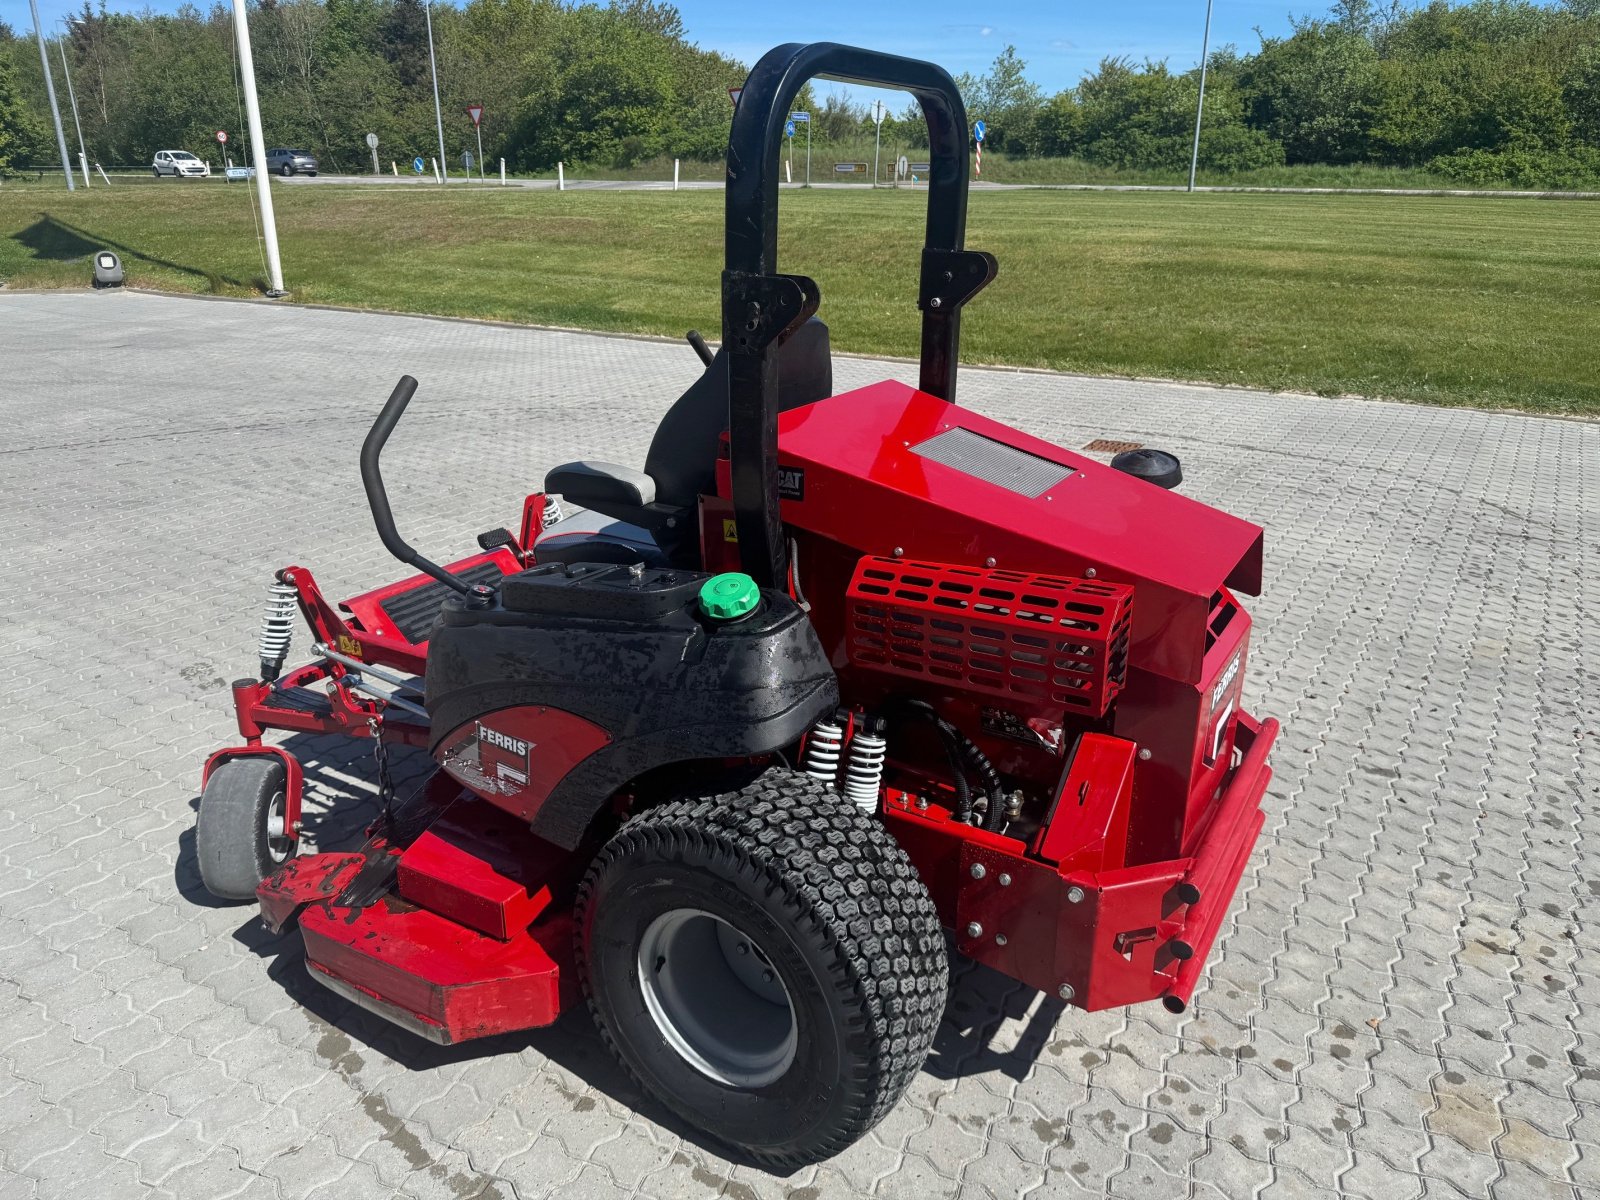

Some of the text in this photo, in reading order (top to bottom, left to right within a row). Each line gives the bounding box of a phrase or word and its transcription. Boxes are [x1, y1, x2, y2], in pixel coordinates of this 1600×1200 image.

[778, 470, 801, 489] CAT
[1211, 652, 1240, 711] FERRIS
[480, 725, 526, 756] FERRIS
